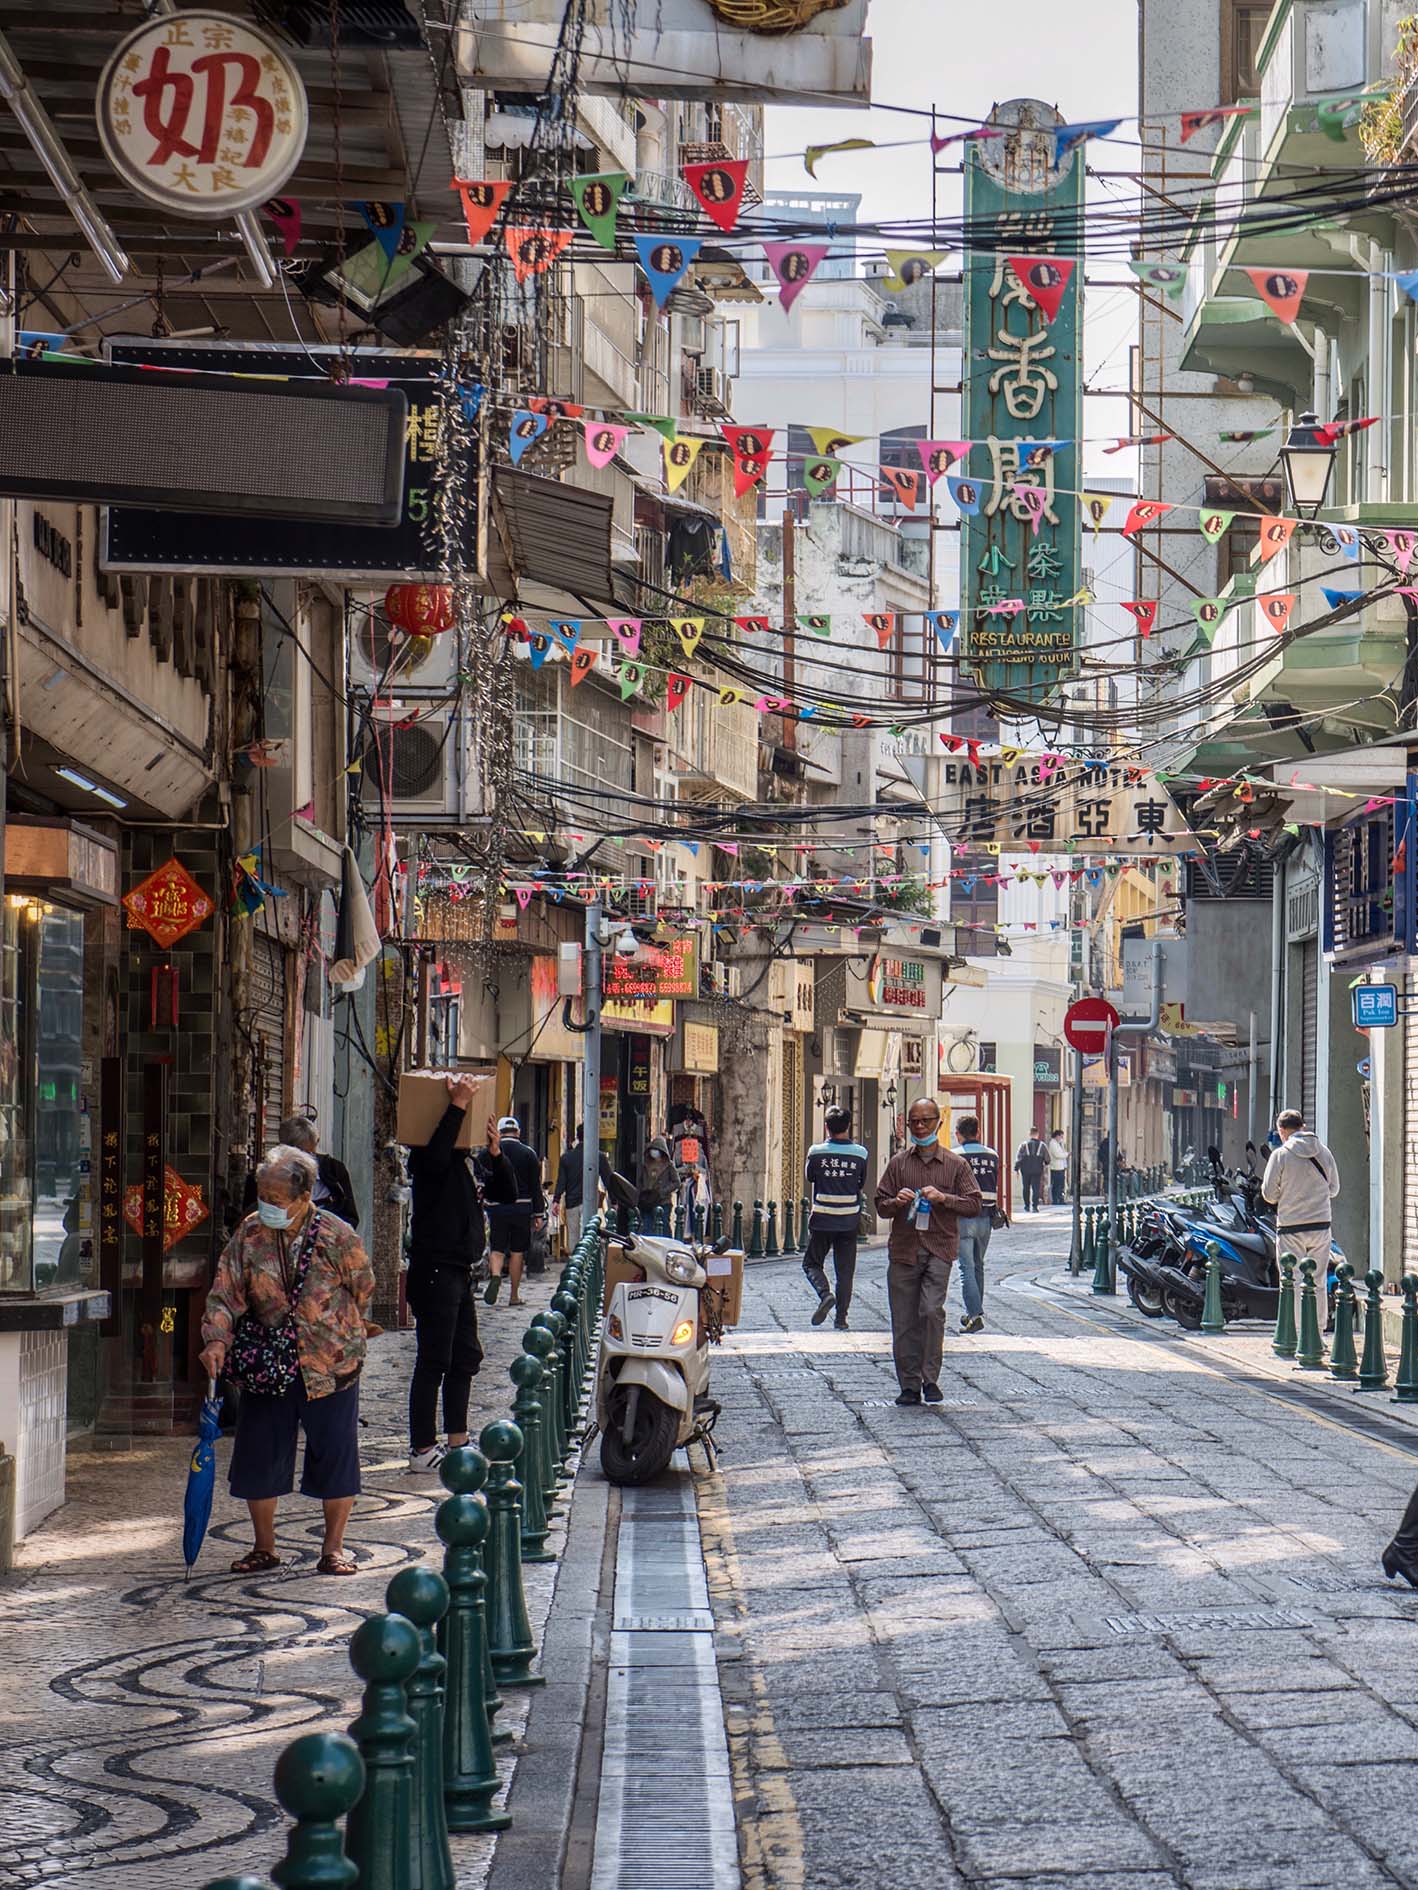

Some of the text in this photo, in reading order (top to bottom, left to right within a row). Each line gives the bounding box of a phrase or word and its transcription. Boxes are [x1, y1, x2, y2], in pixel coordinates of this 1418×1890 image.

[161, 21, 235, 49] 正宗
[132, 46, 275, 169] 奶
[169, 163, 246, 192] 大良
[946, 764, 1003, 785] EAST
[1360, 992, 1392, 1009] 百潤
